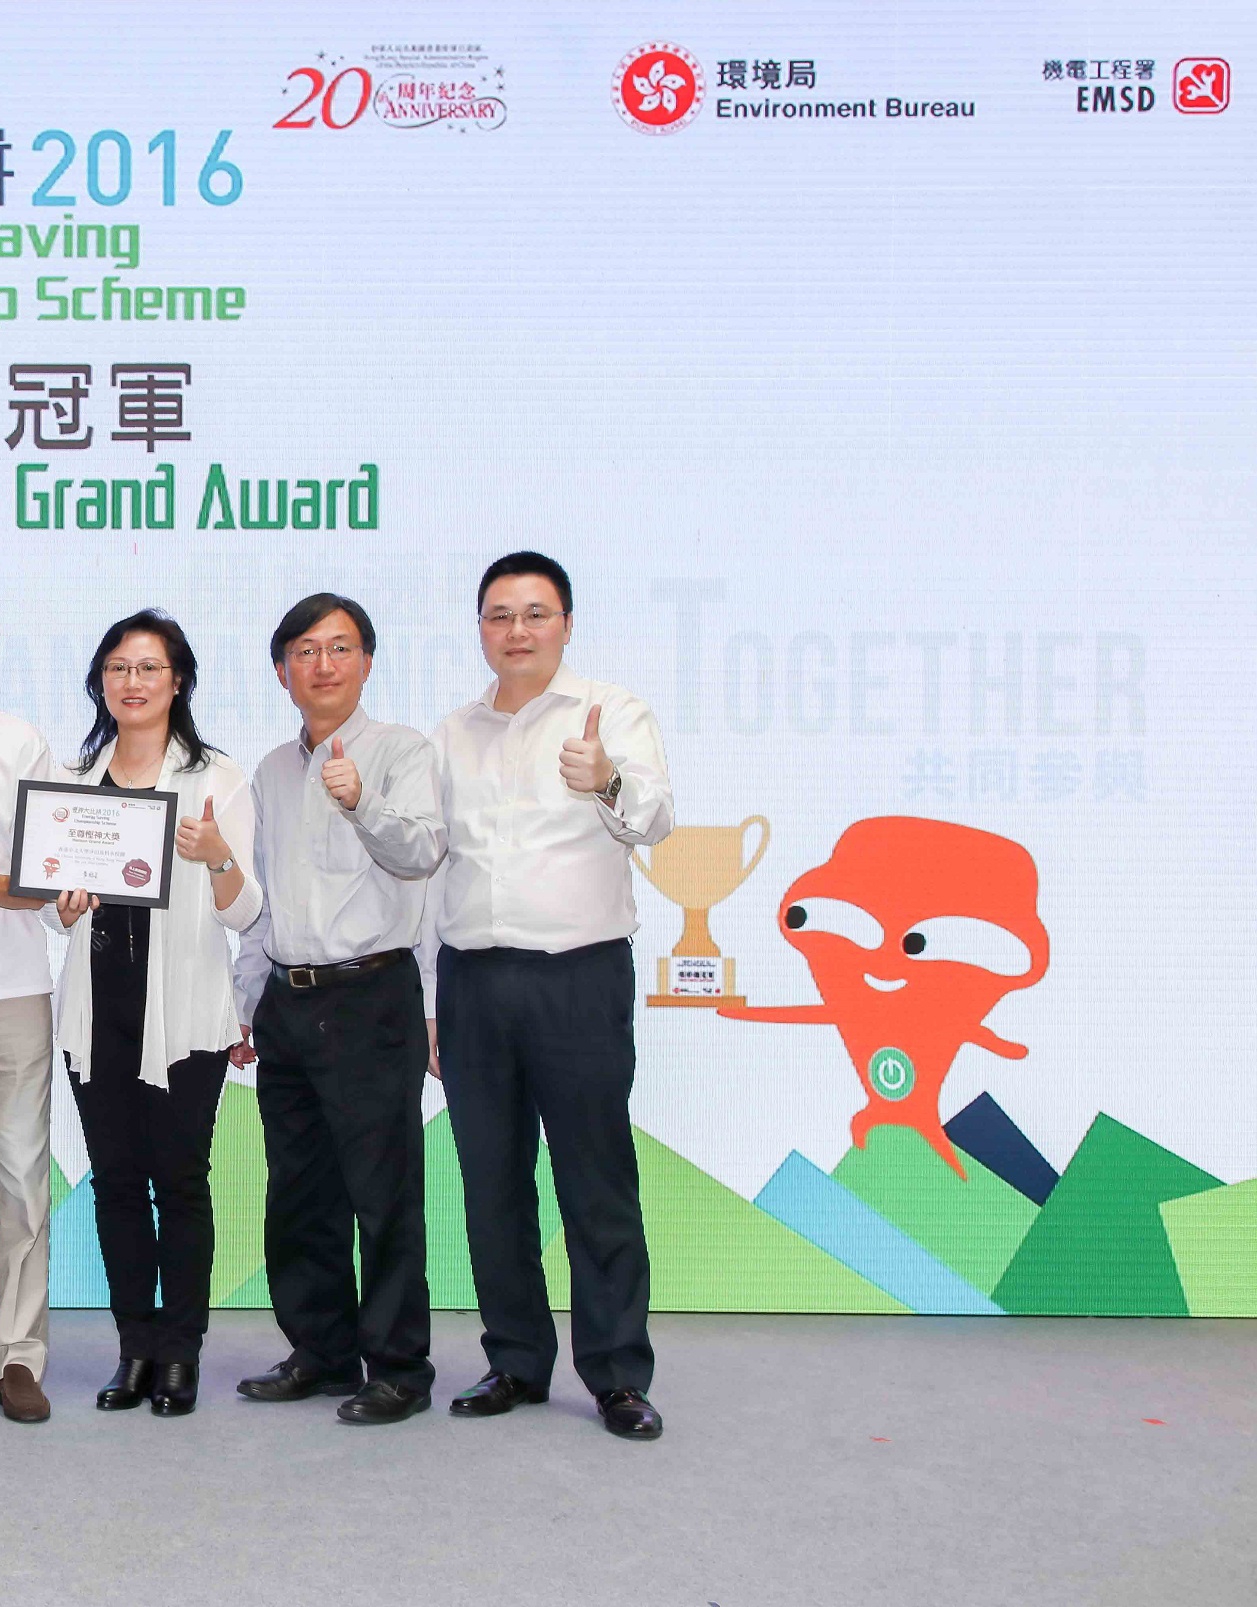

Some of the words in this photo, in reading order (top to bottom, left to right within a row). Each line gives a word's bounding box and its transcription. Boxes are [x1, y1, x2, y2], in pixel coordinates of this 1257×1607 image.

[716, 59, 816, 90] 環境局
[1042, 59, 1155, 81] 機電工程署
[272, 67, 372, 129] 20
[383, 101, 497, 119] ANNIVERSARY
[717, 98, 877, 118] Environment
[886, 98, 975, 117] Bureau
[1077, 86, 1155, 113] EMSD
[32, 130, 243, 206] 2016
[37, 276, 246, 321] Scheme
[16, 463, 175, 530] Grand
[196, 463, 379, 530] Award
[649, 578, 1149, 736] TOGETHER
